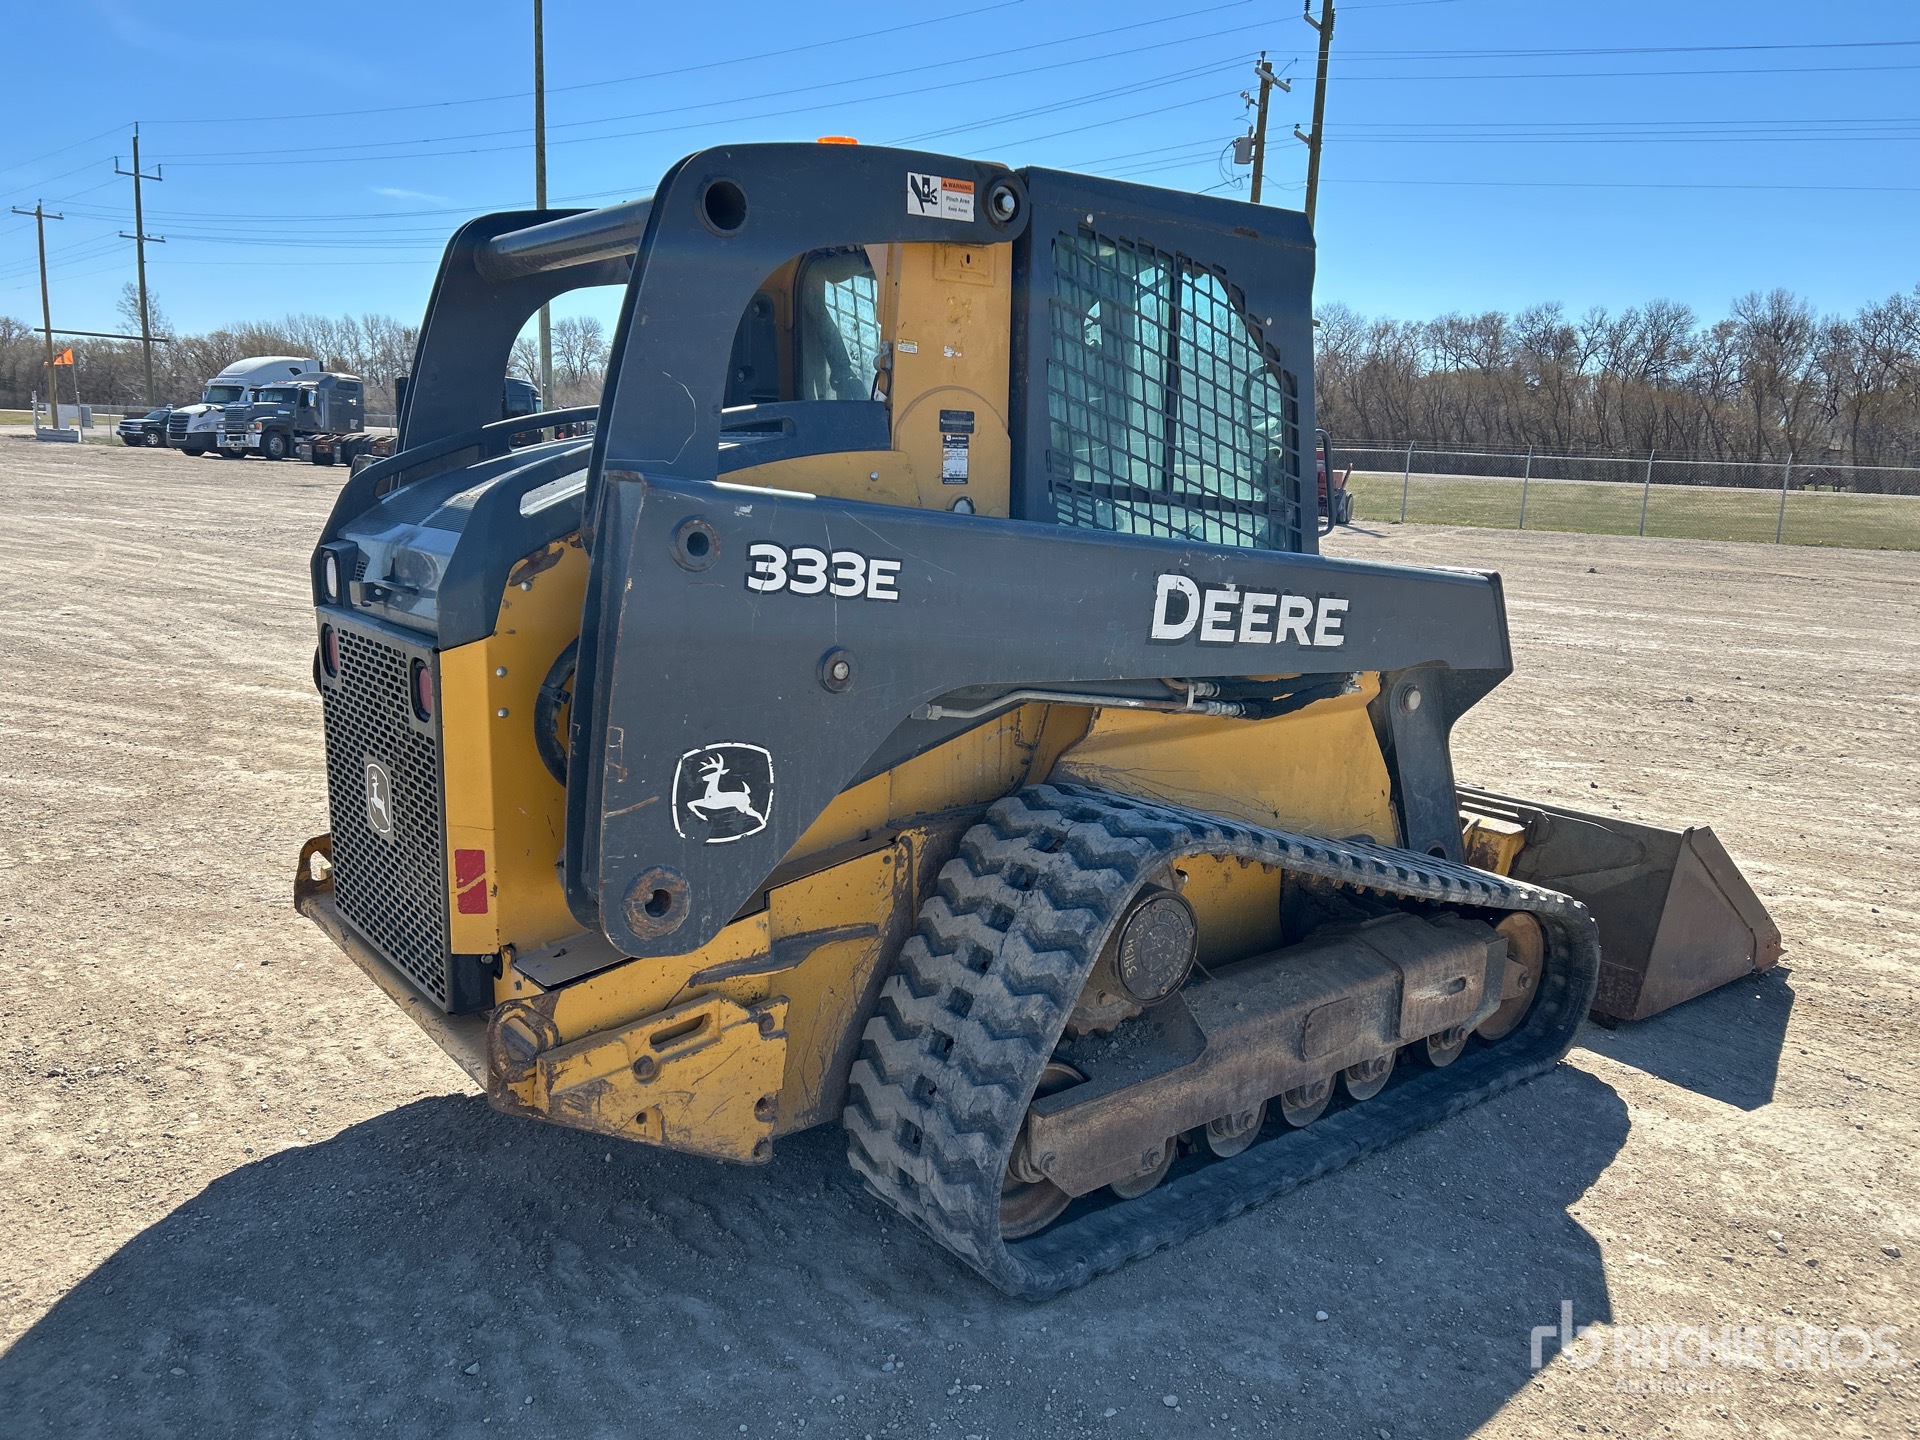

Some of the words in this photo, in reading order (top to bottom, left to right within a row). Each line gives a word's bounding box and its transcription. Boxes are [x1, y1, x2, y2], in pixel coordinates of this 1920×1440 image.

[946, 195, 959, 203] Pinch
[948, 182, 972, 191] WARNING
[747, 543, 901, 601] 333E
[1151, 573, 1349, 647] DEERE
